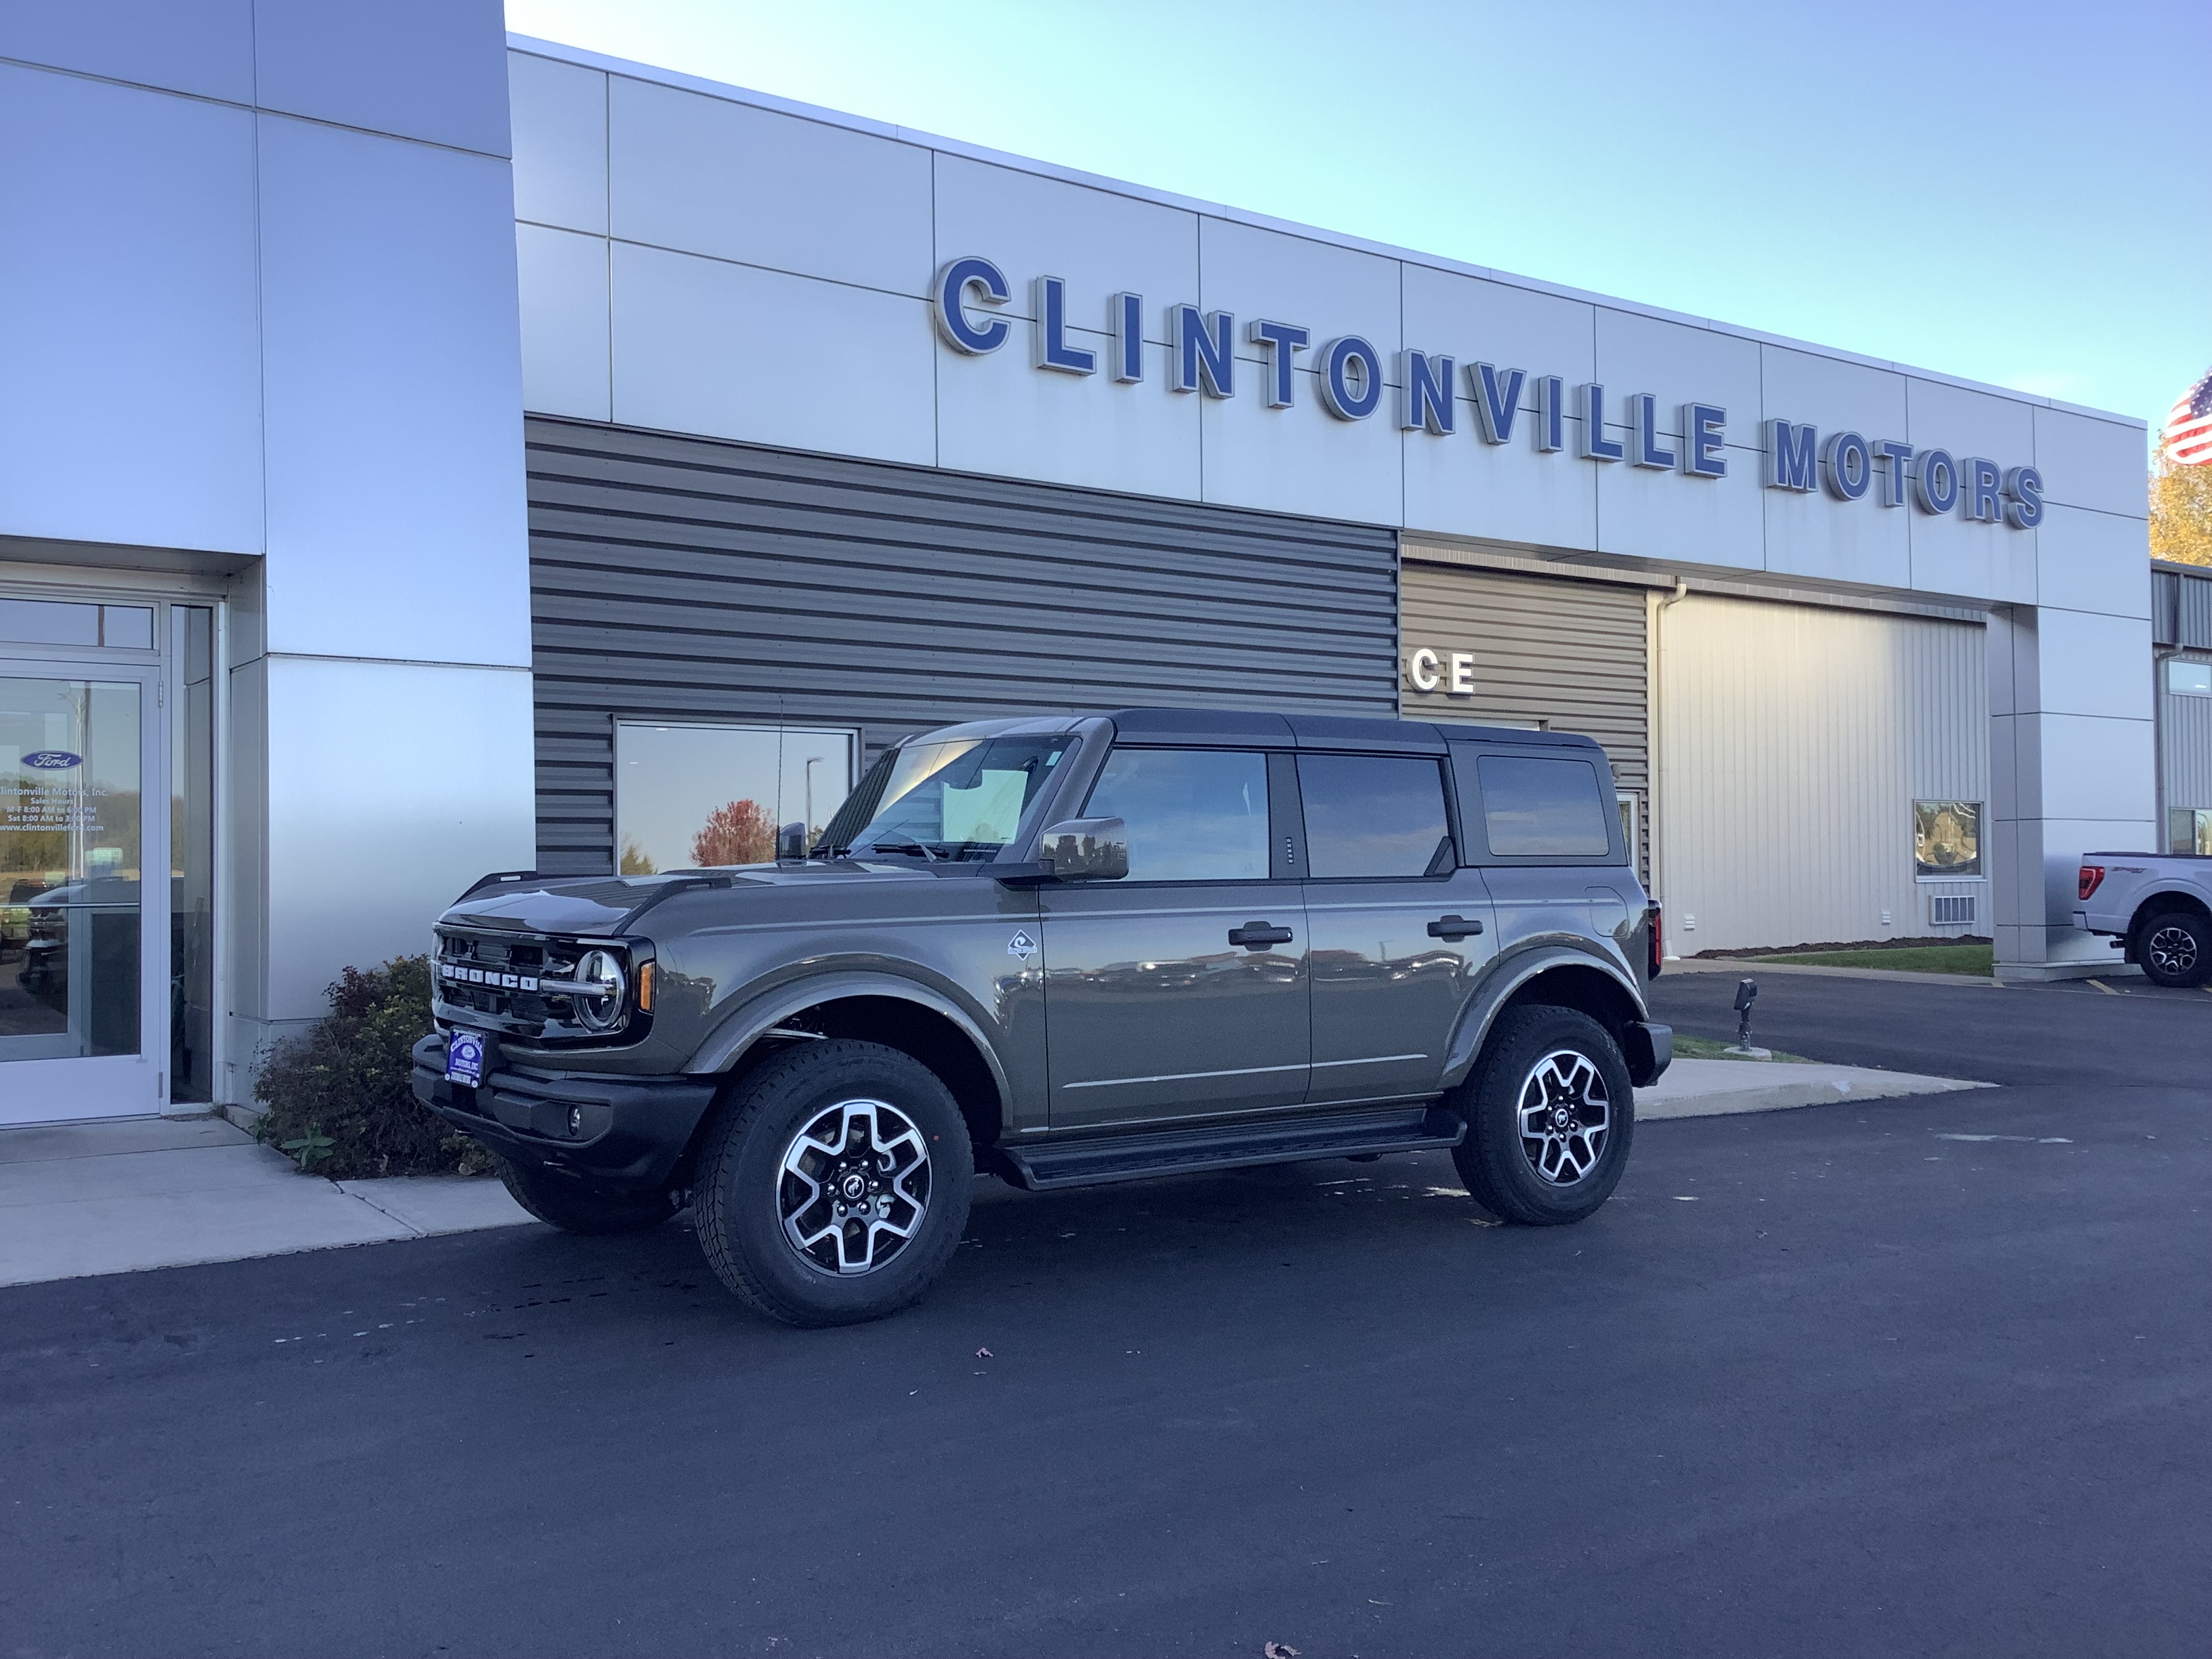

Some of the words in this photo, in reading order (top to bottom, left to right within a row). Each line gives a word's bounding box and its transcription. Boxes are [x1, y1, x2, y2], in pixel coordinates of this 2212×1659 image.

[934, 255, 1727, 479] CLINTONVILLE
[1766, 418, 2045, 530] MOTORS
[34, 753, 70, 767] Ford
[0, 787, 49, 796] lintonville
[52, 787, 89, 797] Motors,
[91, 788, 108, 796] Inc.
[442, 964, 538, 991] BRONCO
